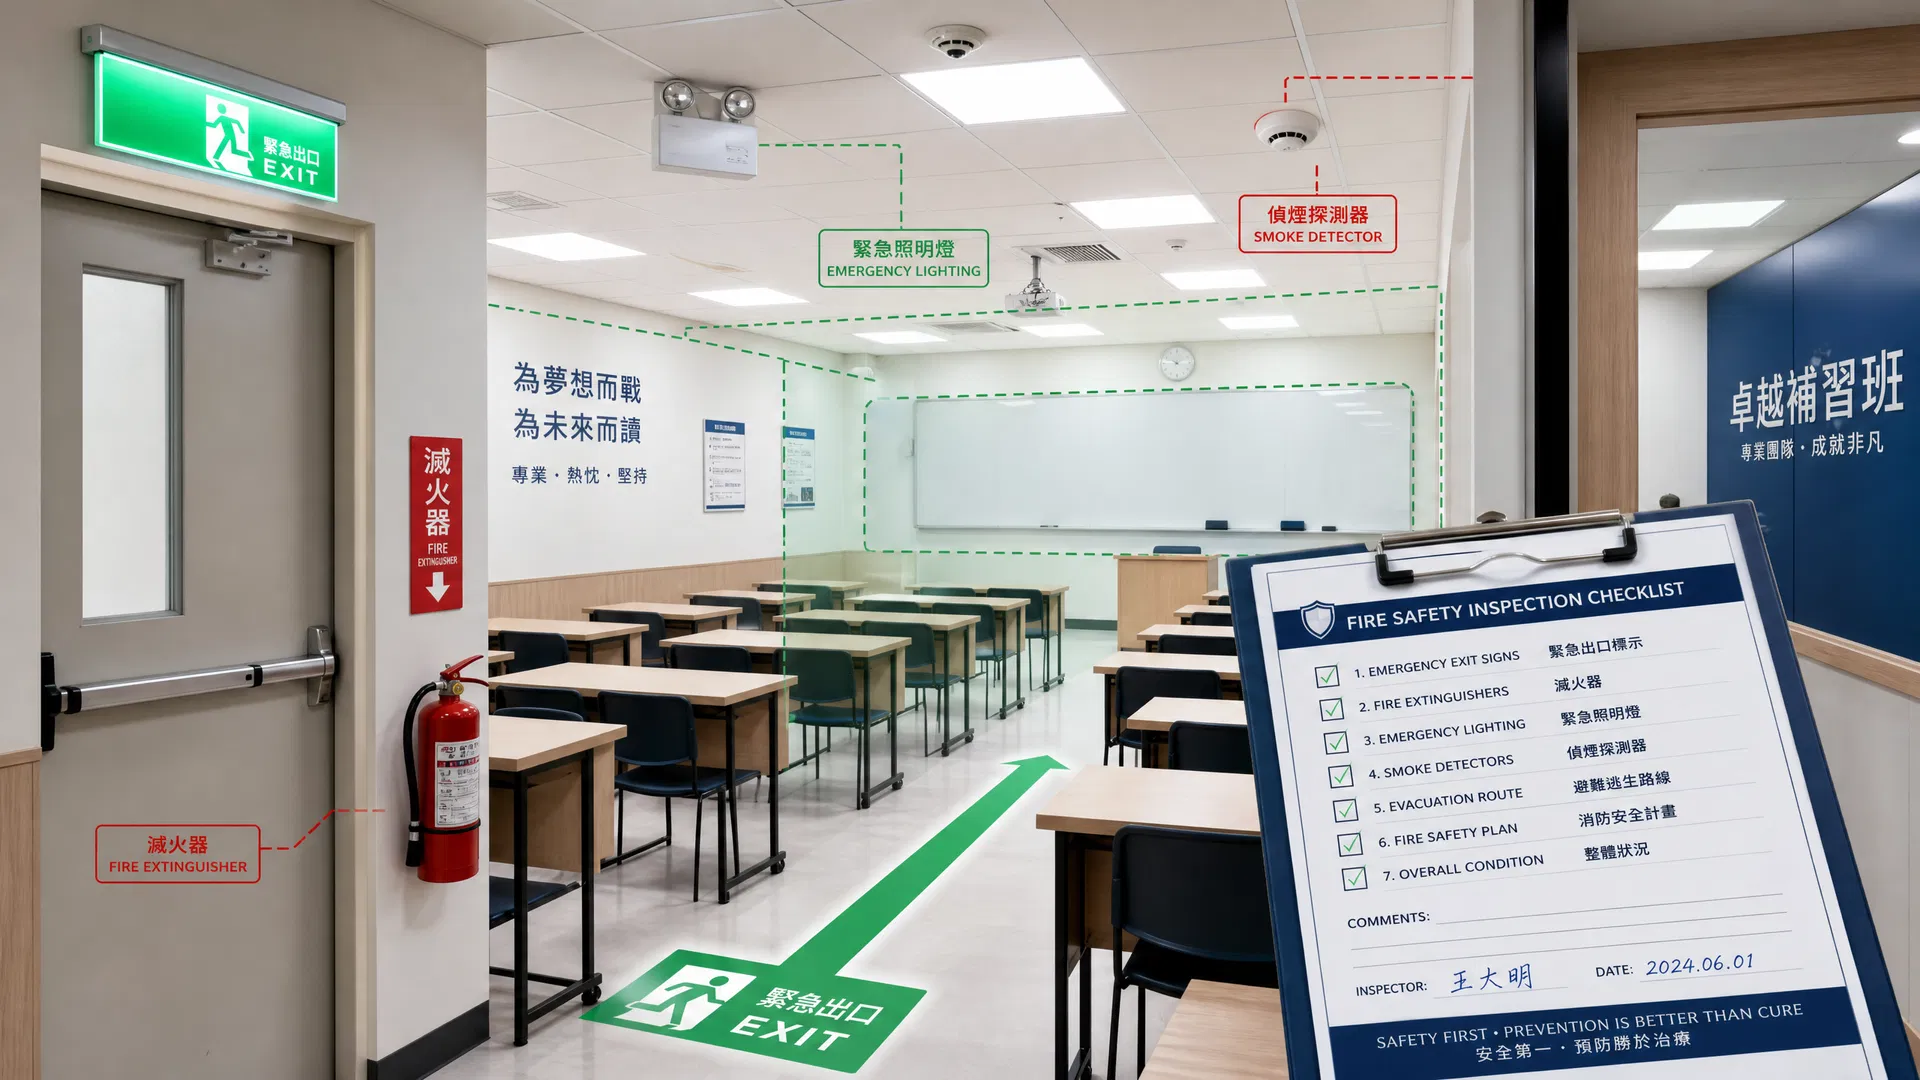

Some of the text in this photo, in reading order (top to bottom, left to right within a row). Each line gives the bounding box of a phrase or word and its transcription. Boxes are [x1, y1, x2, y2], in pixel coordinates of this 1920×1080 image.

[264, 136, 320, 167] 緊急出口
[264, 158, 319, 185] EXIT
[513, 361, 641, 403] 為夢想而戰
[1730, 349, 1904, 432] 卓越補習班
[513, 408, 641, 444] 為未來而讀
[424, 447, 451, 536] 滅火器
[428, 543, 448, 554] FIRE
[1347, 582, 1684, 630] FIRE SAFETY INSPECTION CHECKLIST
[1549, 637, 1643, 658] 緊急出口標示
[1355, 651, 1519, 678] 1. EMERGENCY EXIT SIGNS
[1359, 686, 1509, 712] 2. FIRE EXTINGUISHERS
[1561, 705, 1641, 726] 緊急照明燈
[1364, 719, 1525, 745] 3. EMERGENCY LIGHTING
[1567, 739, 1646, 760] 偵煙探測器
[1369, 755, 1514, 779] 4. SMOKE DETECTORS
[1574, 771, 1671, 793] 避難逃生路線
[1374, 788, 1523, 813] 5. EVACUATION ROUTE
[1379, 823, 1517, 847] 6. FIRE SAFETY PLAN
[1584, 842, 1649, 861] 整體狀況
[1383, 855, 1543, 881] 7. OVERALL CONDITION
[1348, 912, 1430, 928] COMMENTS:
[1596, 965, 1633, 977] DATE:
[1646, 954, 1752, 975] 2024.06.01
[1356, 982, 1427, 996] INSPECTOR:
[1451, 964, 1532, 993] 王大明
[756, 987, 884, 1025] 緊急出口
[730, 1015, 850, 1051] EXIT
[1377, 1004, 1803, 1048] SAFETY FIRST PREVENTION IS BETTER THAN CURE
